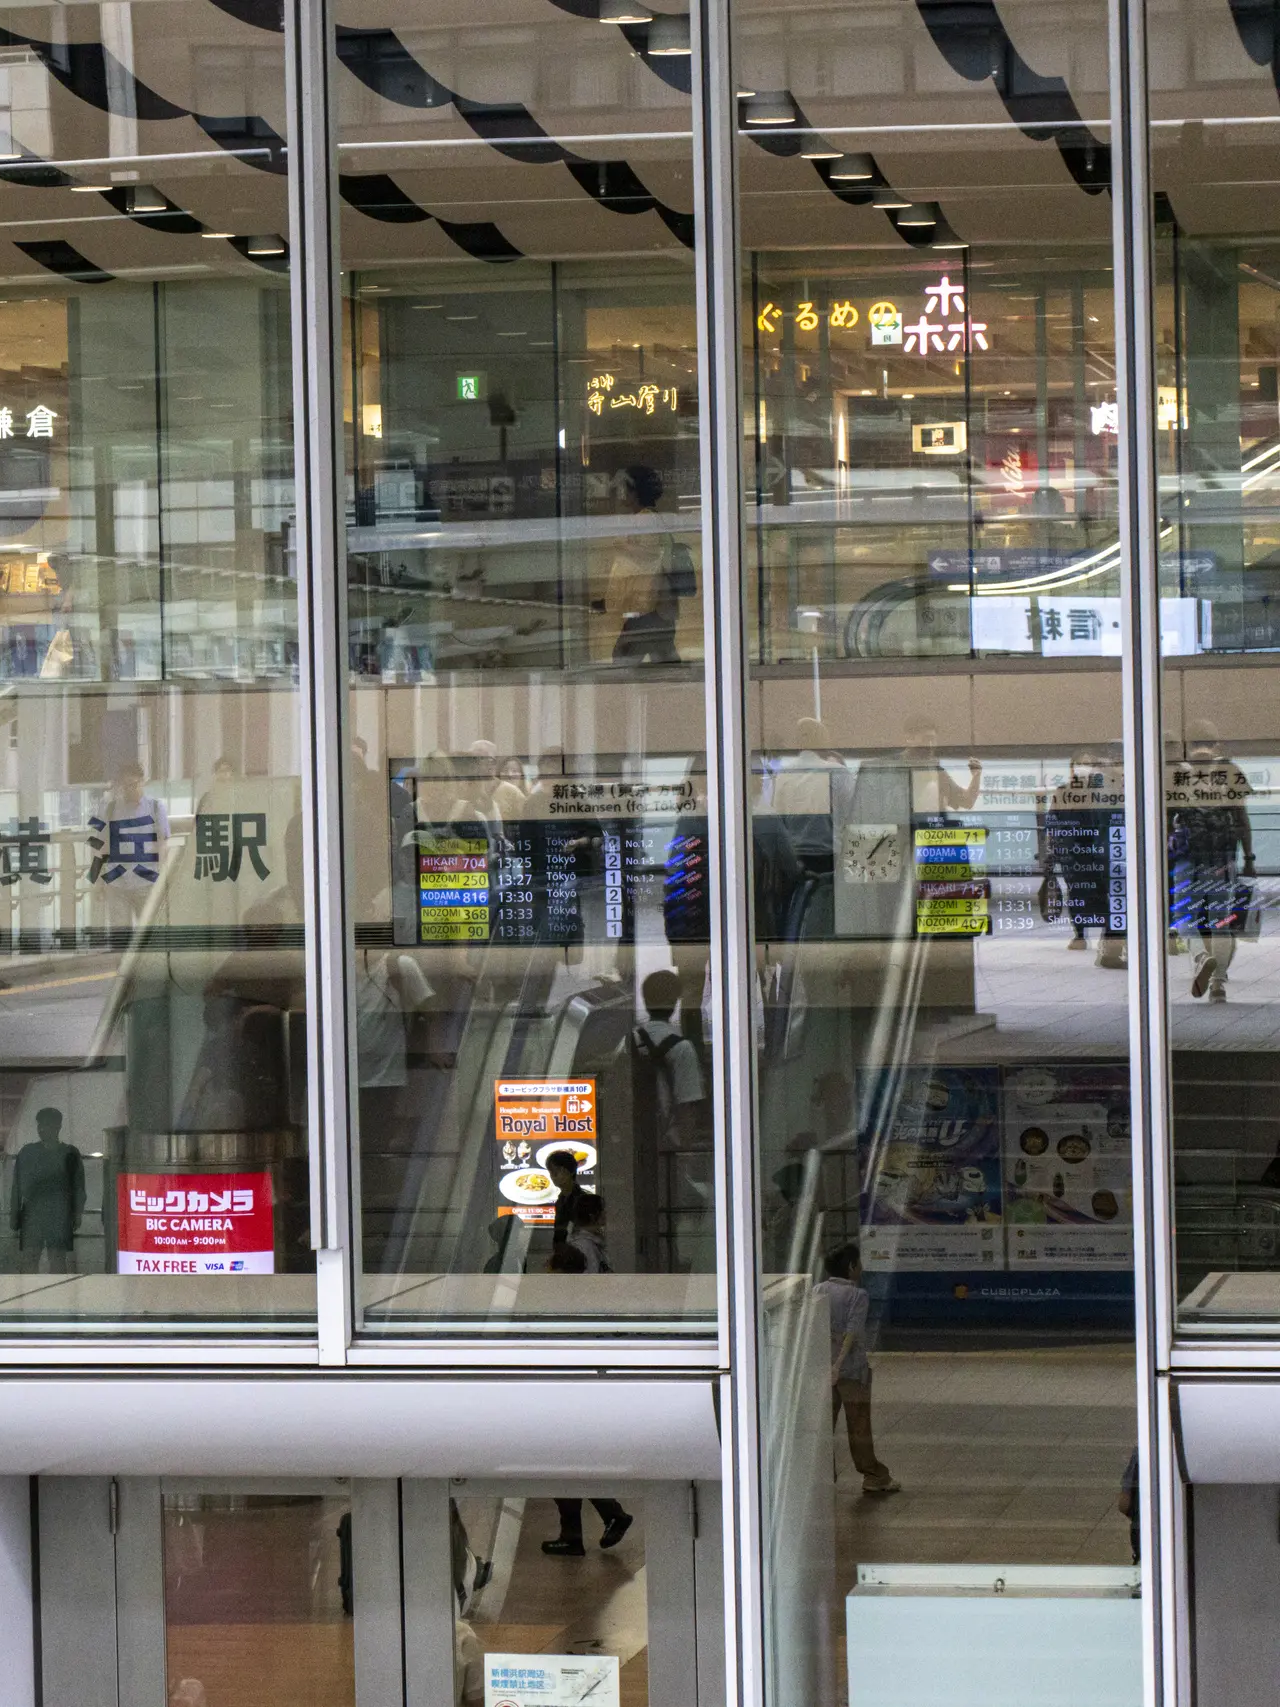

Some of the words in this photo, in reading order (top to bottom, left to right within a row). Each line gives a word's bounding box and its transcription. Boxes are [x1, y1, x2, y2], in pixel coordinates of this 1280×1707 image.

[549, 802, 622, 814] Shinkansen
[917, 831, 956, 839] NOZOMI
[964, 832, 978, 842] 71
[996, 831, 1032, 842] 13:07
[1046, 828, 1100, 837] Hiroshima
[1112, 828, 1122, 840] 4
[916, 848, 957, 857] KODAMA
[960, 849, 984, 860] 827
[996, 848, 1033, 859] 13:15
[1113, 846, 1122, 858] 3
[423, 857, 459, 866] HIKARI
[463, 858, 486, 869] 704
[498, 857, 532, 869] 13:25
[546, 854, 576, 865] Tōkyō
[608, 856, 618, 868] 2
[625, 857, 655, 865] No.1-5
[917, 866, 957, 875] NOZOMI
[1113, 864, 1122, 876] 4
[422, 874, 460, 883] NOZOMI
[462, 875, 487, 886] 250
[499, 874, 533, 886] 13:27
[546, 871, 577, 883] Tōkyō
[610, 873, 617, 885] 1
[626, 874, 654, 883] No.1,2
[920, 883, 956, 891] HIKARI
[996, 883, 1032, 894] 13:21
[1113, 881, 1122, 893] 3
[422, 891, 461, 900] KODAMA
[462, 892, 487, 903] 816
[499, 891, 533, 903] 13:30
[546, 888, 577, 899] Tōkyō
[609, 890, 619, 902] 2
[918, 901, 958, 909] NOZOMI
[965, 901, 981, 912] 35
[997, 900, 1032, 912] 13:31
[1047, 898, 1085, 907] Hakata
[1113, 898, 1122, 910] 3
[423, 908, 460, 917] NOZOMI
[464, 909, 488, 920] 368
[499, 908, 533, 920] 13:33
[547, 905, 578, 916] Tōkyō
[611, 907, 617, 918] 1
[918, 918, 958, 927] NOZOMI
[962, 918, 985, 930] 407
[997, 918, 1034, 930] 13:39
[1048, 913, 1106, 925] Shin-Ōsaka
[1114, 916, 1123, 929] 3
[423, 925, 461, 934] NOZOMI
[467, 926, 484, 937] 90
[499, 926, 534, 937] 13:38
[611, 924, 618, 935] 1
[500, 1115, 547, 1136] Royal
[553, 1115, 594, 1132] Host
[130, 1189, 255, 1213] ビックカメラ
[145, 1218, 168, 1231] BIC
[169, 1218, 234, 1231] CAMERA
[135, 1259, 162, 1273] TAX
[163, 1260, 197, 1273] FREE
[204, 1262, 225, 1271] VISA
